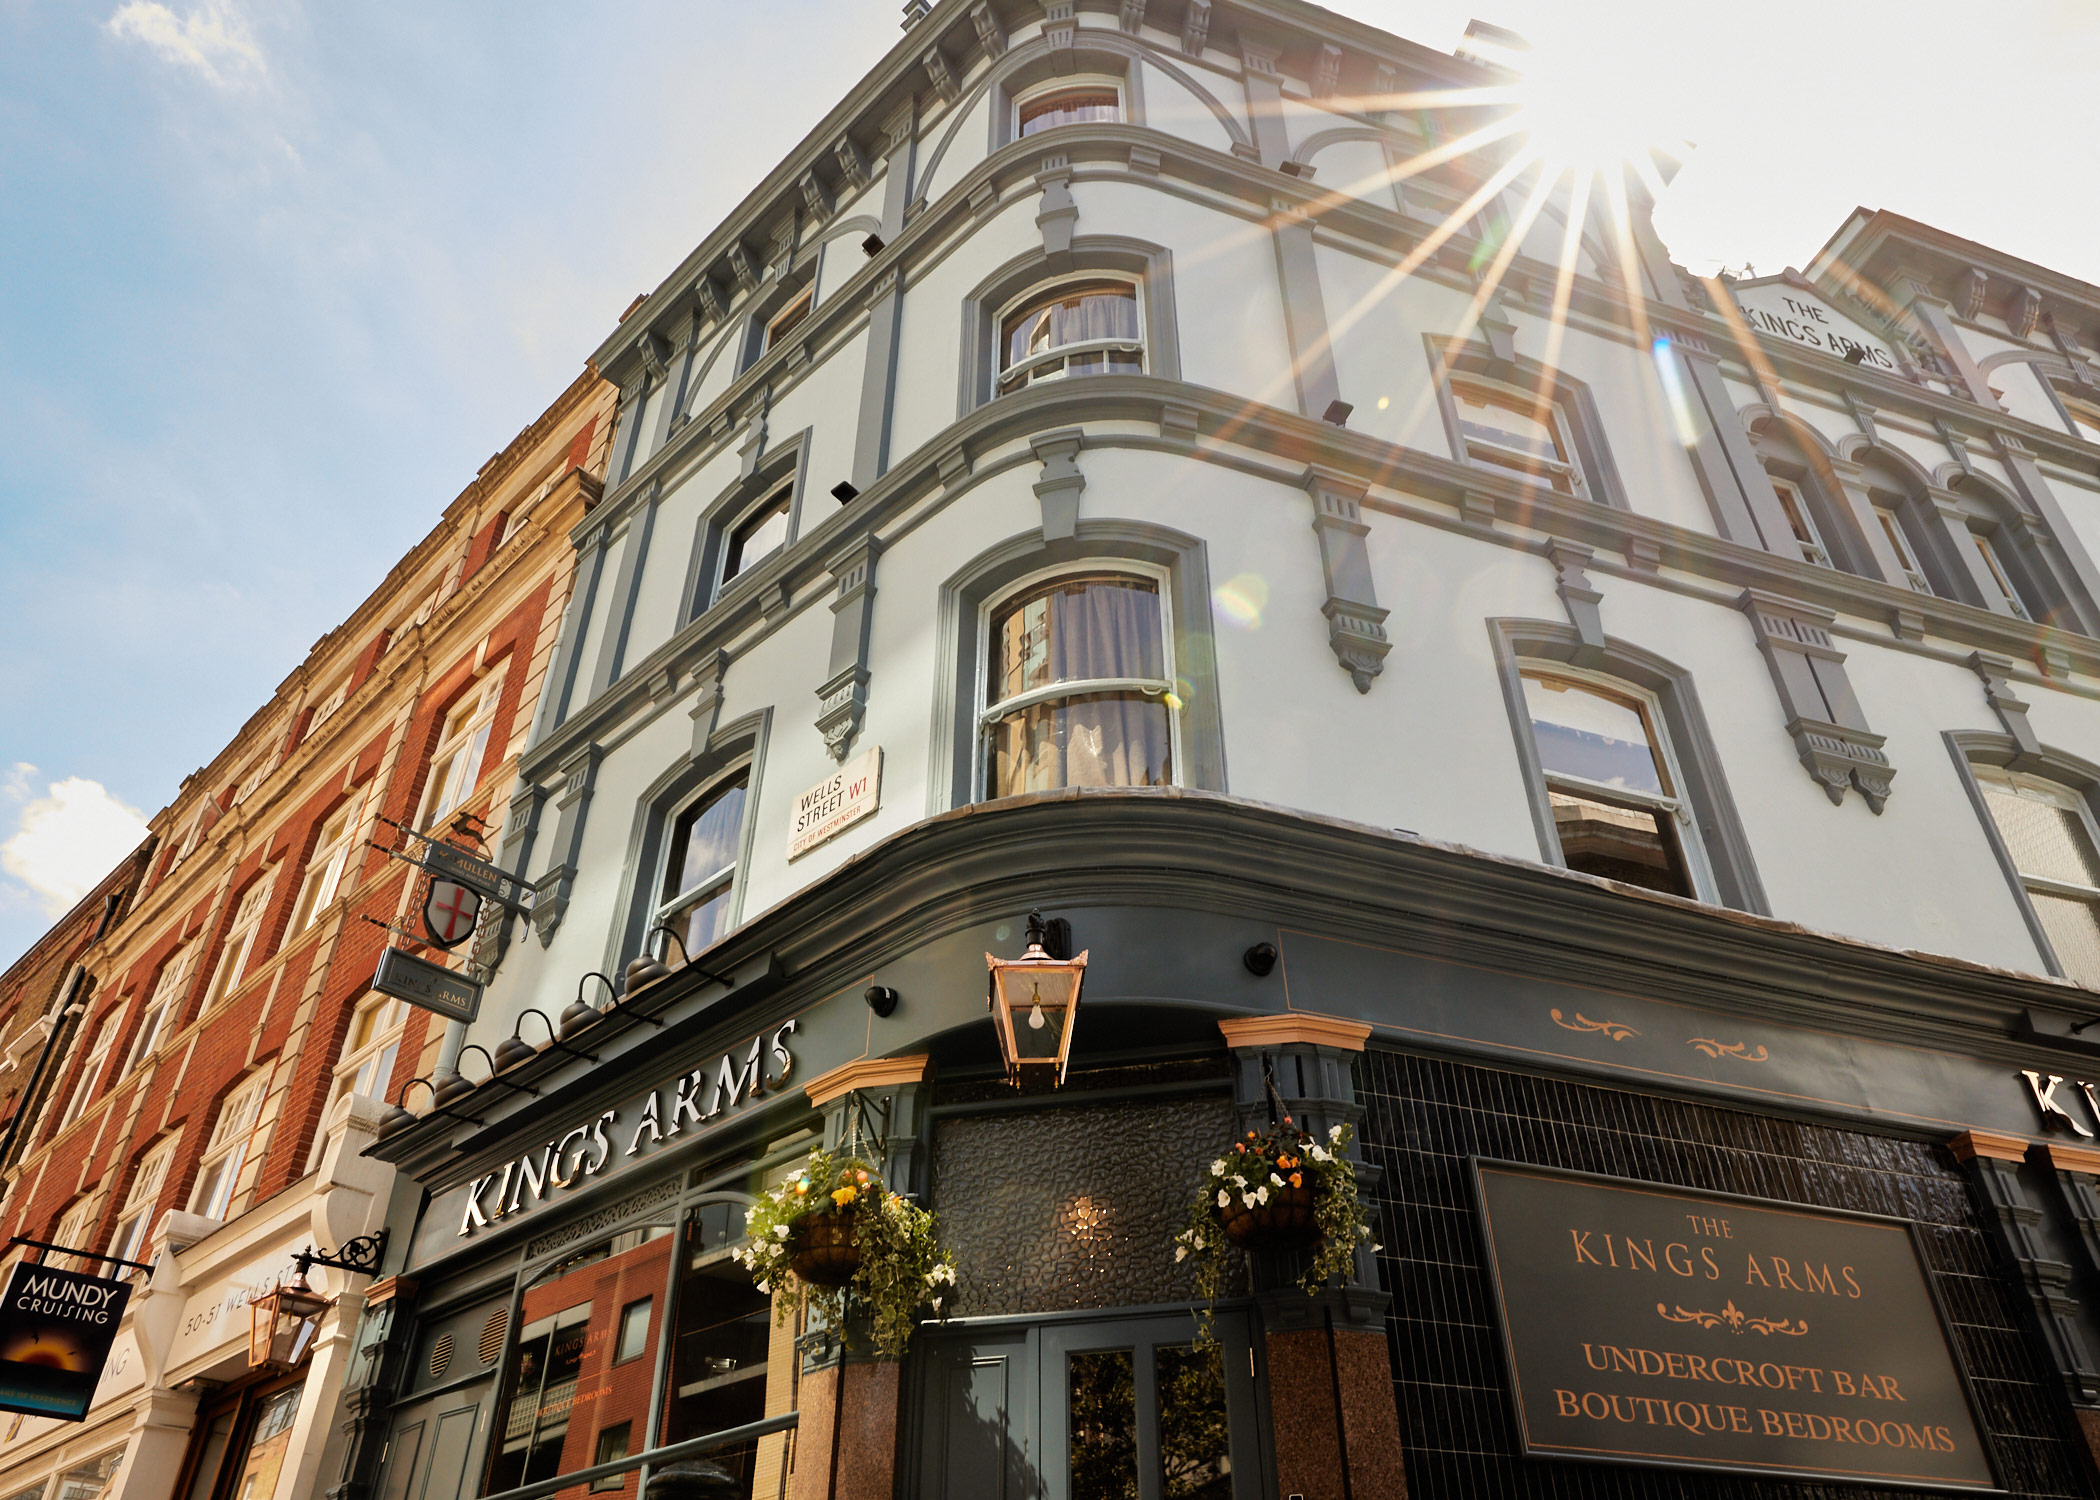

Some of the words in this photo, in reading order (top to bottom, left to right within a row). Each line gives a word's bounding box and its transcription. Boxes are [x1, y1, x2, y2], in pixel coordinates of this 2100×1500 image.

[1782, 296, 1829, 325] THE
[1740, 305, 1822, 347] KINGS
[1827, 332, 1893, 369] ARMS
[797, 790, 845, 832] STREET
[849, 776, 867, 800] W1
[801, 774, 842, 812] WELLS
[793, 839, 806, 852] CITY
[808, 832, 816, 843] OF
[817, 805, 861, 837] WESTMINSTER
[457, 1110, 616, 1237] KINGS
[624, 1018, 799, 1157] ARMS
[1686, 1214, 1733, 1239] THE
[1569, 1229, 1720, 1280] KINGS
[1745, 1252, 1861, 1299] ARMS
[17, 1296, 109, 1324] CRUISING
[22, 1274, 118, 1309] MUNDY
[184, 1303, 222, 1336] 50-51
[226, 1276, 270, 1313] WELLS
[555, 1336, 584, 1356] KINGS
[1580, 1342, 1823, 1393] UNDERCROFT
[1830, 1369, 1907, 1402] BAR
[1552, 1388, 1753, 1436] BOUTIQUE
[1757, 1408, 1956, 1453] BEDROOMS
